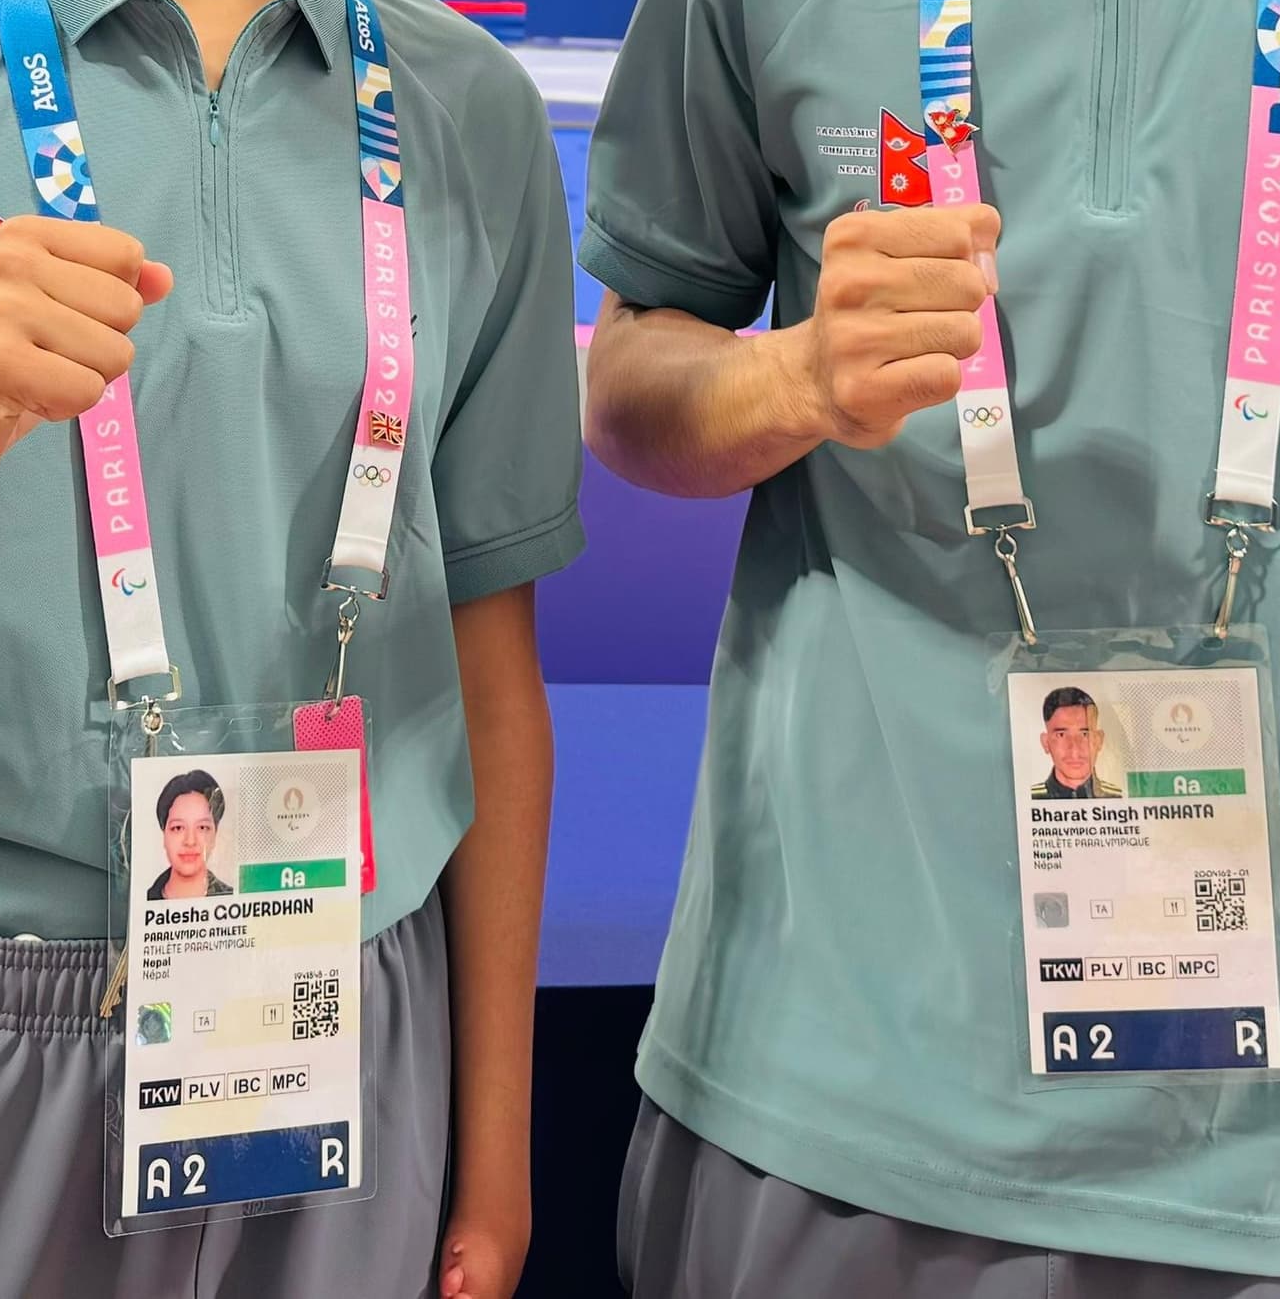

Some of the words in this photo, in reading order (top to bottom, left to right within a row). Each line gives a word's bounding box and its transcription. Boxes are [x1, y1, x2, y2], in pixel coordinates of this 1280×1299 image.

[22, 52, 58, 113] Atos
[838, 164, 877, 176] NEPAL
[374, 219, 398, 320] PARIS
[1243, 263, 1277, 366] PARIS
[374, 331, 400, 406] 202
[97, 418, 135, 534] PARIS
[1173, 775, 1201, 795] Aa
[1031, 807, 1088, 822] Bharat
[1092, 805, 1139, 823] Singh
[1143, 803, 1214, 820] MAHATA
[1032, 827, 1097, 837] PARALYMPIC
[1100, 825, 1141, 835] ATHLETE
[1075, 836, 1150, 848] PARALYMPIQUE
[1033, 850, 1063, 860] Nepal
[280, 866, 306, 888] Aa
[144, 906, 209, 926] Palesha
[214, 897, 314, 921] GOVERDHAN
[143, 928, 207, 943] PARALYMPIC
[209, 925, 248, 938] ATHLETE
[184, 937, 256, 953] PARALYMPIQUE
[142, 957, 171, 969] Nepal
[1041, 963, 1082, 979] TKW
[1090, 962, 1124, 977] PLV
[1138, 961, 1167, 976] IBC
[1178, 960, 1216, 975] MPC
[1052, 1024, 1079, 1061] A
[1089, 1024, 1115, 1060] 2
[1235, 1020, 1263, 1056] R
[141, 1085, 180, 1105] TKW
[188, 1081, 221, 1099] PLV
[233, 1077, 261, 1094] IBC
[272, 1072, 307, 1090] MPC
[146, 1157, 171, 1200] A
[182, 1154, 207, 1195] 2
[321, 1137, 345, 1178] R
